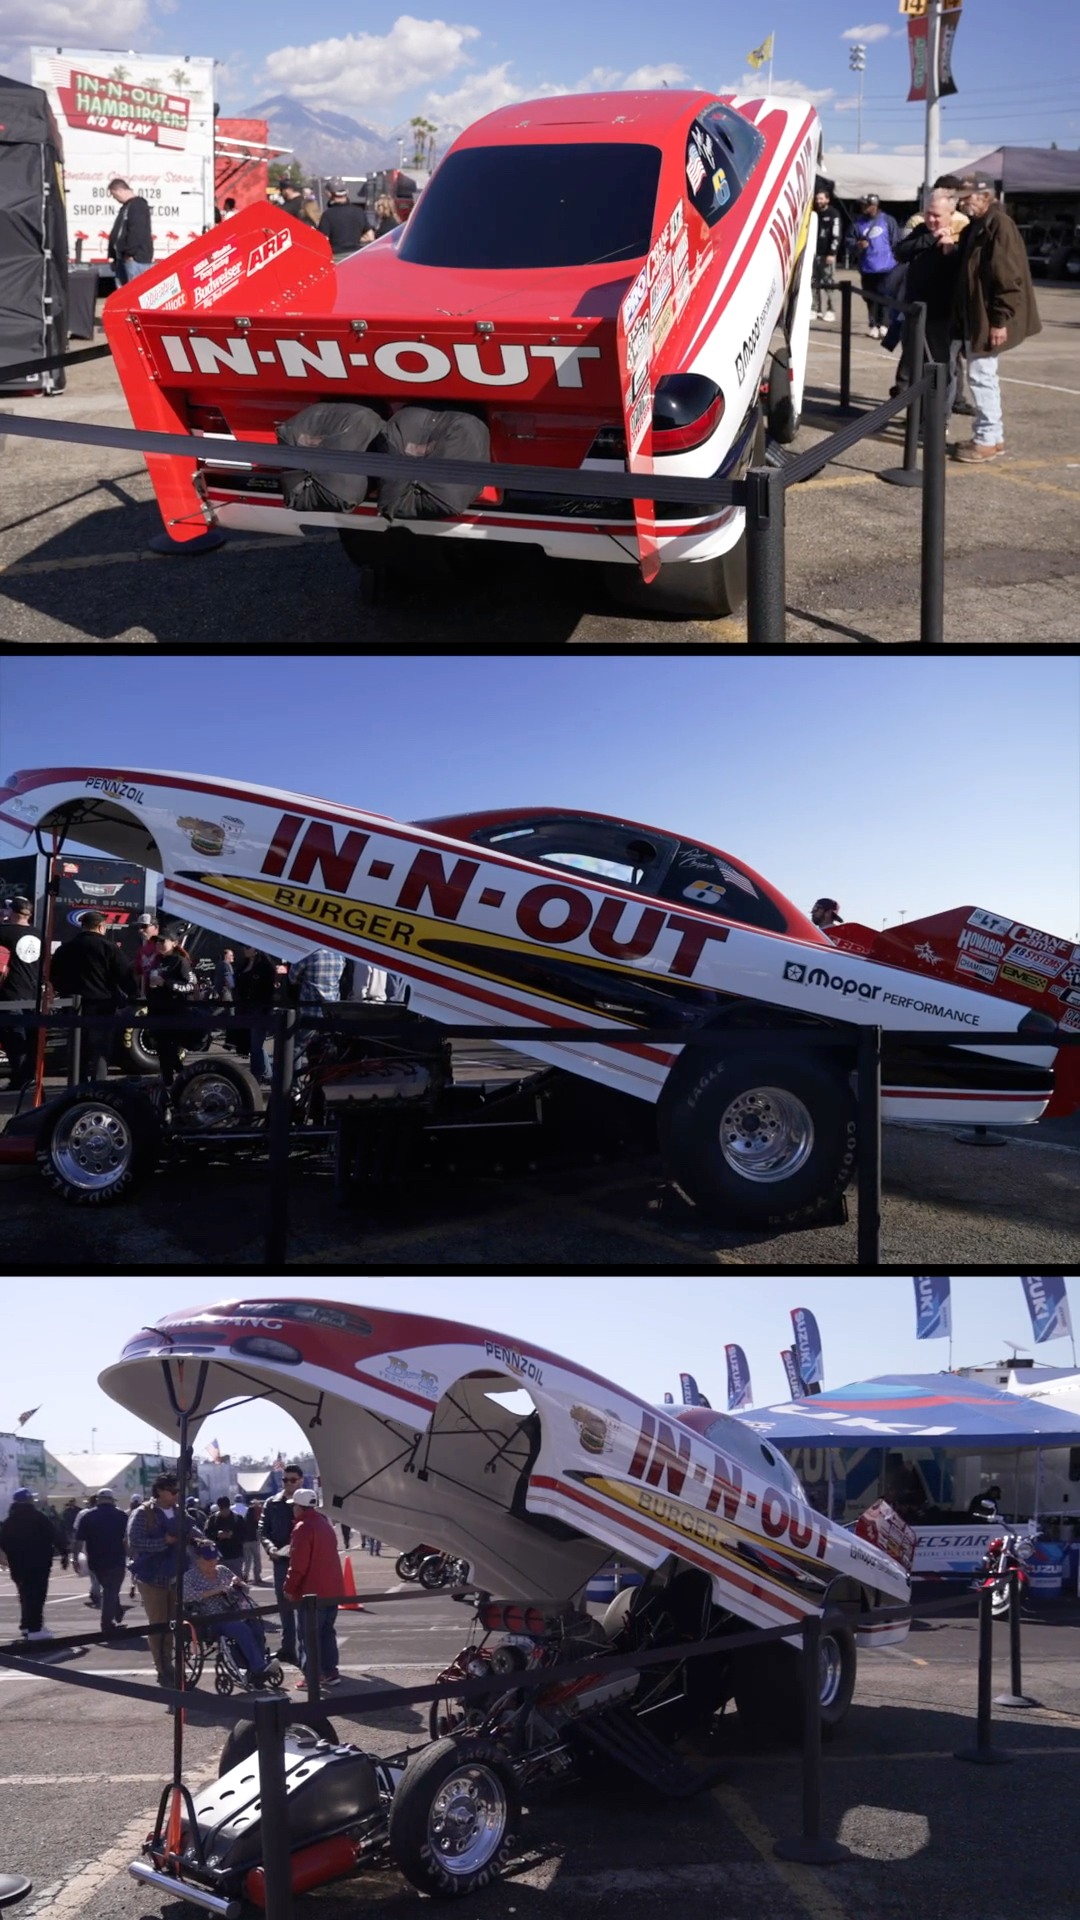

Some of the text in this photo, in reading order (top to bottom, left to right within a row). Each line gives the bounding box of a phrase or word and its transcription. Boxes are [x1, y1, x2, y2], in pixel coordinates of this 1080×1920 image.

[76, 74, 168, 109] IN-N-OUT
[76, 92, 188, 129] HAMBURGERS
[87, 115, 152, 136] NO DELAY
[711, 167, 730, 207] 6
[248, 229, 292, 275] ARP
[193, 261, 243, 305] Budweiser
[160, 335, 601, 388] IN-N-OUT
[85, 776, 146, 805] PENNZOIL
[260, 813, 730, 978] IN-N-OUT
[682, 880, 727, 904] 6
[273, 888, 415, 946] BURGER
[957, 928, 1006, 958] HOWARDS
[960, 958, 995, 978] CHAMPION
[808, 967, 981, 1027] Mopar PERFORMANCE
[794, 1310, 812, 1368] SUZUKI
[485, 1340, 544, 1387] PENNZOIL
[727, 1345, 742, 1393] SUZUKI
[783, 1351, 801, 1400] SUZUKI
[628, 1410, 833, 1560] IN-N-OUT
[637, 1491, 719, 1547] BURGER
[917, 1535, 990, 1548] ECSTAR
